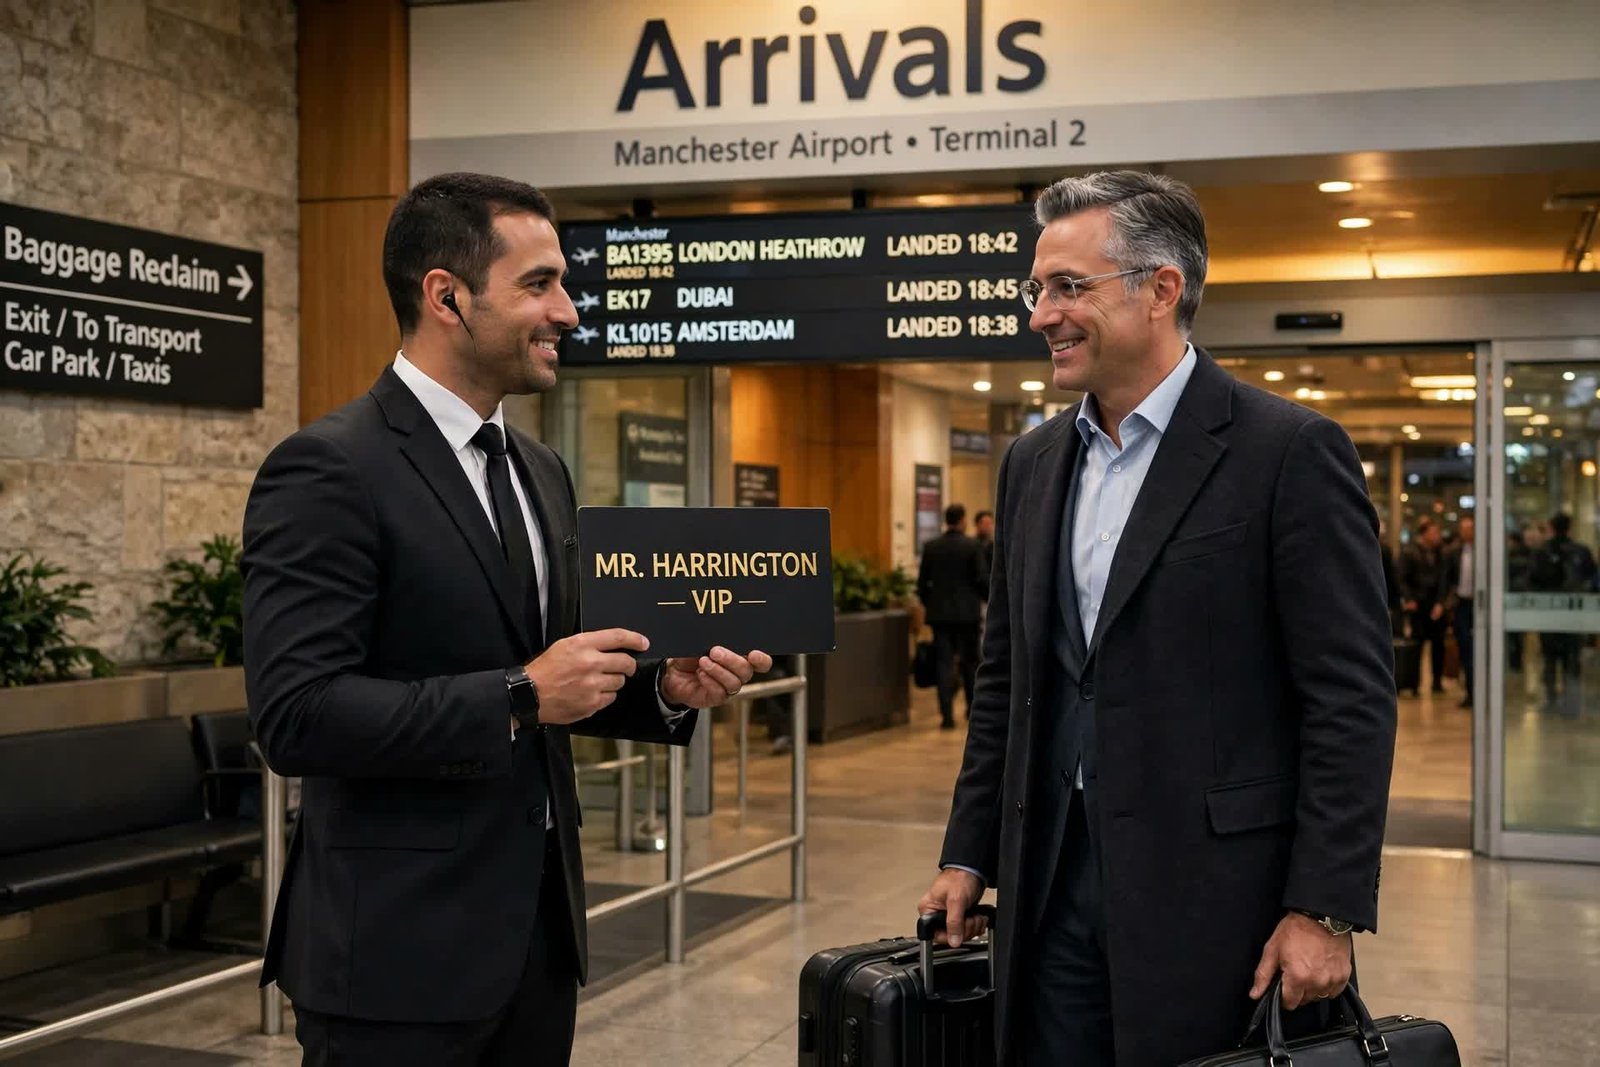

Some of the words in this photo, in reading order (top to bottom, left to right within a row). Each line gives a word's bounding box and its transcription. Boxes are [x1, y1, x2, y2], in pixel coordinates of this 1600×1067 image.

[615, 0, 1047, 113] Arrivals
[615, 137, 778, 167] Manchester
[789, 131, 893, 161] Airport
[930, 120, 1057, 152] Terminal
[1070, 119, 1086, 147] 2
[5, 226, 122, 283] Baggage
[130, 249, 219, 293] Reclaim
[607, 243, 673, 265] BA1395
[679, 240, 755, 262] LONDON
[760, 237, 865, 260] HEATHROW
[887, 234, 962, 256] LANDED
[968, 232, 1017, 253] 18:42
[607, 289, 651, 310] EK17
[677, 287, 733, 308] DUBAI
[887, 280, 962, 302] LANDED
[968, 279, 1018, 300] 18:45
[6, 302, 50, 335] Exit
[73, 311, 99, 340] To
[105, 315, 202, 356] Transport
[607, 323, 672, 343] KL1015
[677, 319, 794, 342] AMSTERDAM
[887, 316, 962, 338] LANDED
[968, 315, 1018, 336] 18:38
[5, 341, 45, 371] Car
[52, 346, 100, 377] Park
[120, 352, 170, 384] Taxis
[596, 553, 644, 577] MR.
[653, 552, 817, 577] HARRINGTON
[692, 590, 732, 613] VIP
